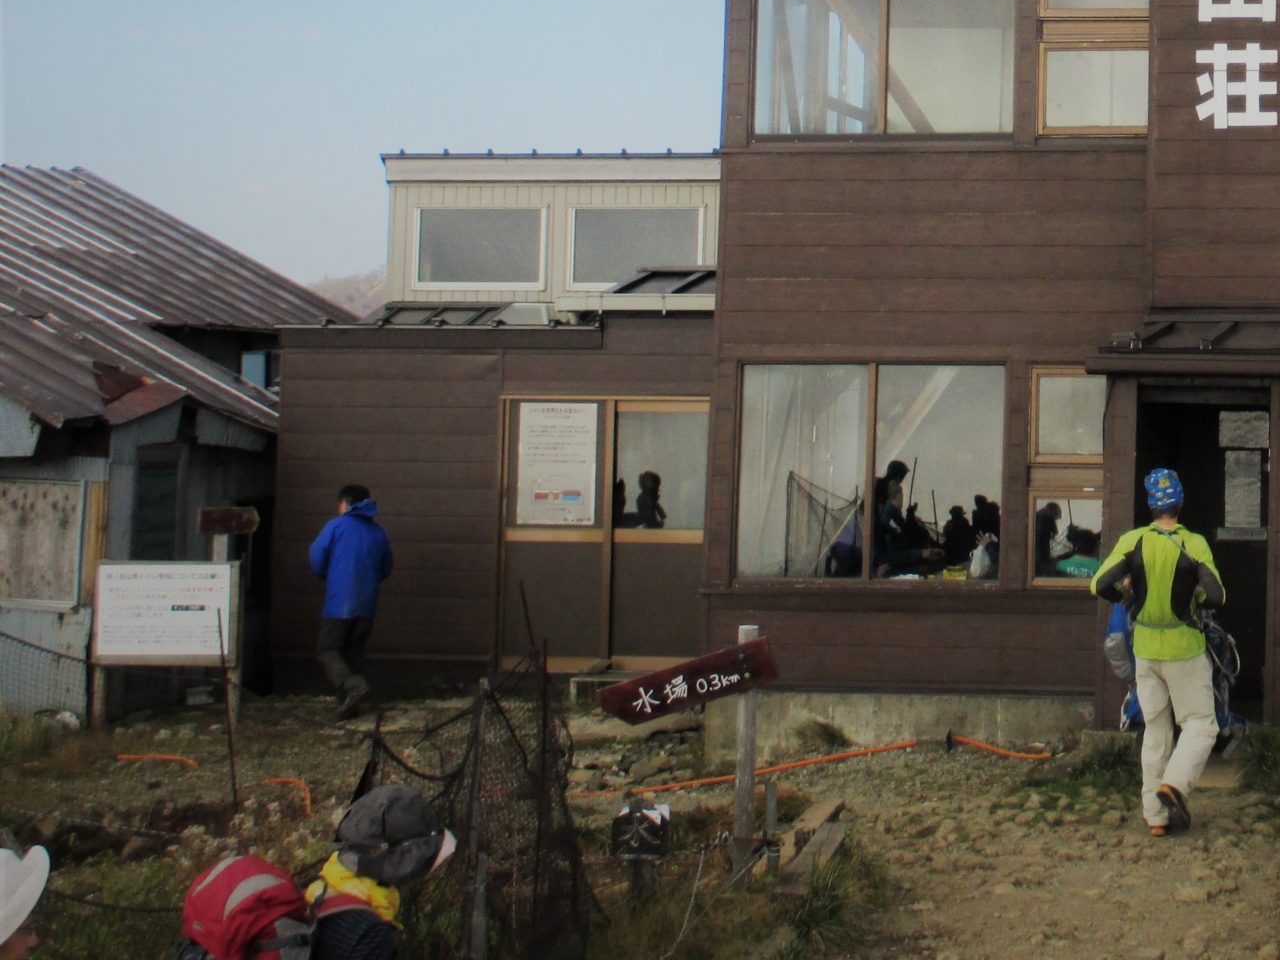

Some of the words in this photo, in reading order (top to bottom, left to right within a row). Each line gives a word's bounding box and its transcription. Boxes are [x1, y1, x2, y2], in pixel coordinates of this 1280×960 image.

[633, 675, 688, 713] 水場
[695, 672, 742, 694] 0.3km
[618, 813, 662, 848] 水
